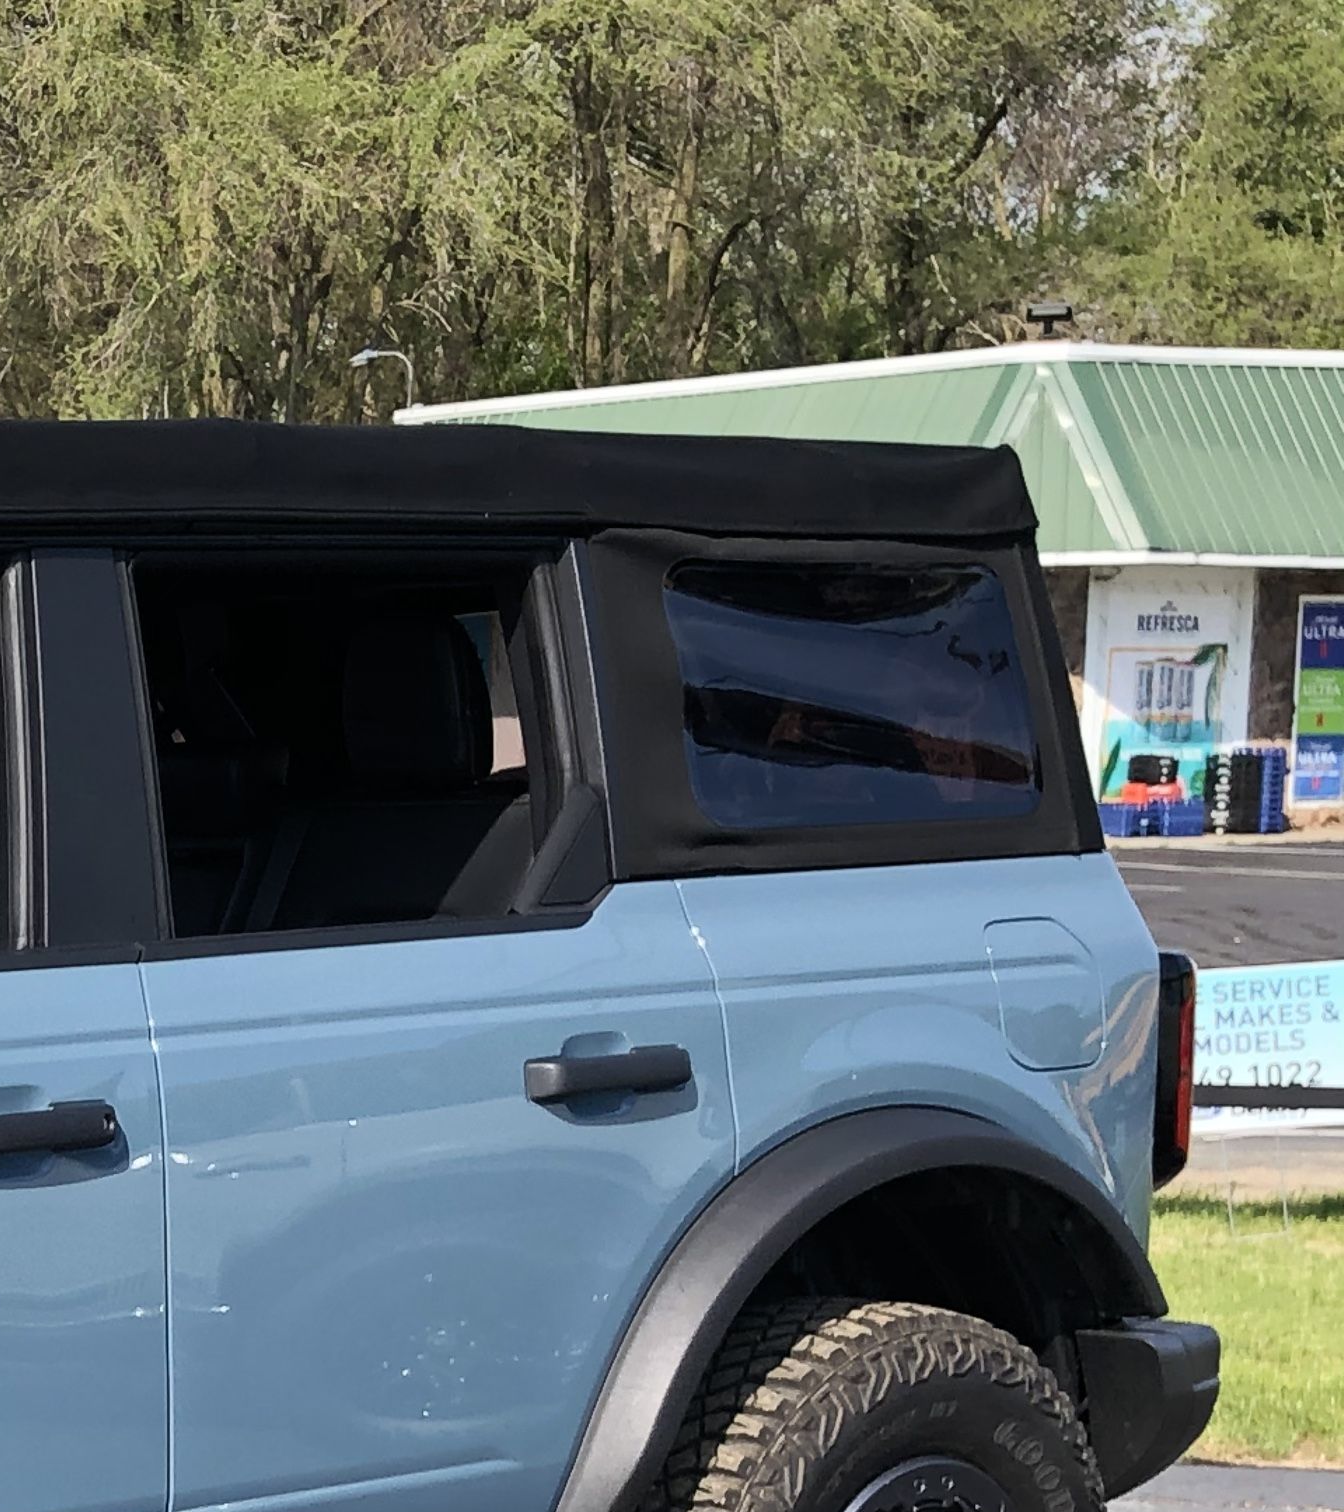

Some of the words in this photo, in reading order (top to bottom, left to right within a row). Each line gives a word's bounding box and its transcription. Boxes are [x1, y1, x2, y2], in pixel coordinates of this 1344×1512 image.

[1137, 614, 1200, 632] REFRESCA
[1213, 975, 1331, 1004] SERVICE
[1215, 1002, 1312, 1031] MAKES
[1321, 1000, 1340, 1023] &
[1194, 1028, 1306, 1057] MODELS
